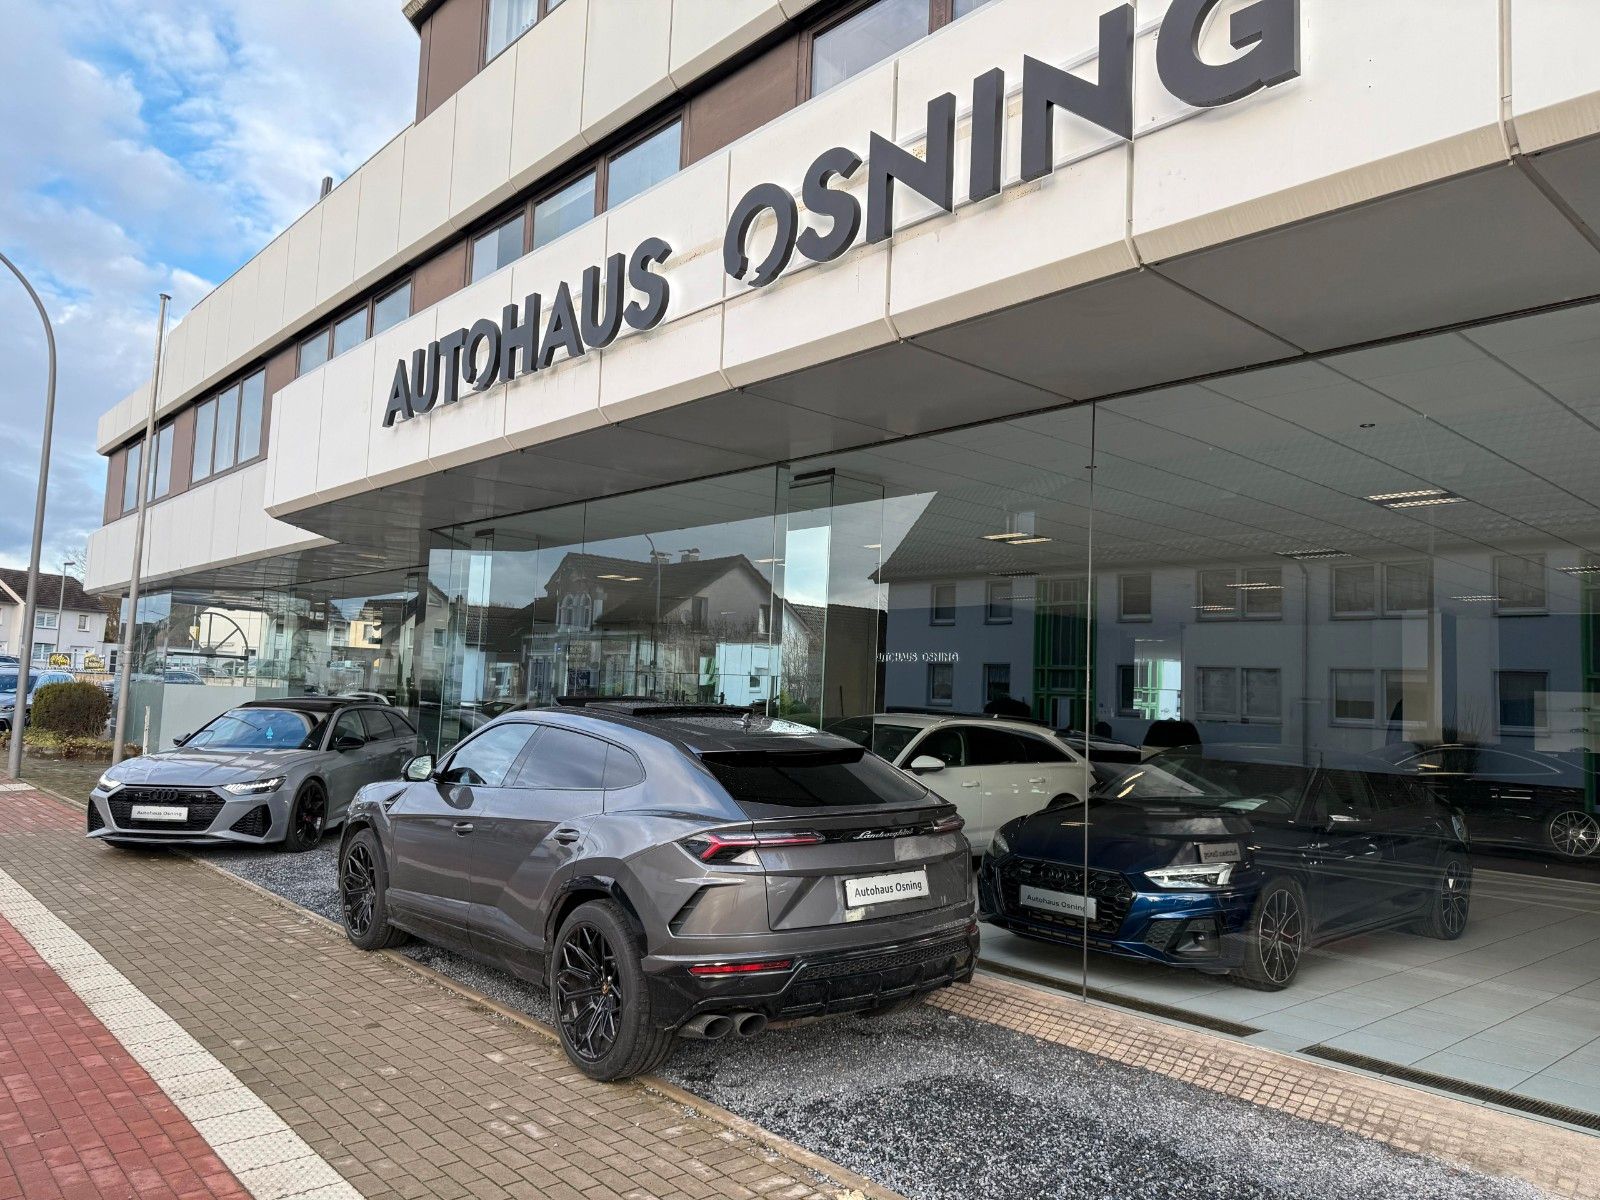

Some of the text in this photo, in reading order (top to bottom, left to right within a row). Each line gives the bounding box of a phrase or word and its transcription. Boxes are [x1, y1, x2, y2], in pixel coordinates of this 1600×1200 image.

[382, 0, 1300, 428] AUTOHAUS OSNING
[853, 829, 914, 840] Lamborghini
[854, 880, 923, 898] Autohaus Osning
[1027, 894, 1060, 906] Autohaus
